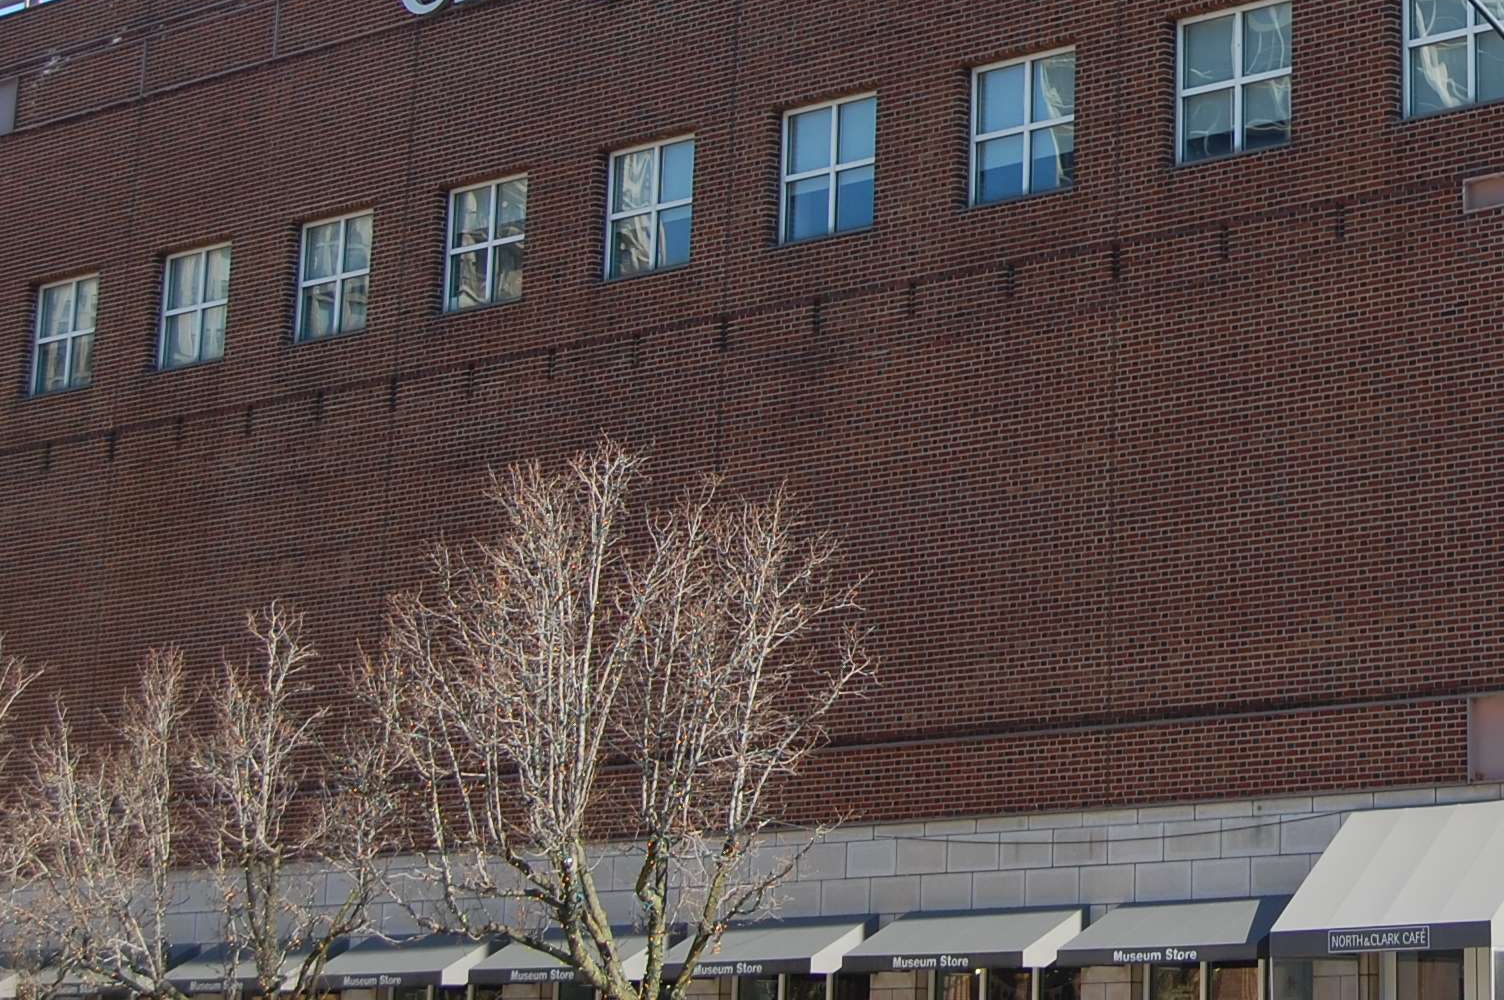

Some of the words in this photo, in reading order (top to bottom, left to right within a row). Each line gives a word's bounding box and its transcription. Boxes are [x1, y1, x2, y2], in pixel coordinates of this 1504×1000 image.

[1402, 927, 1427, 945] CAFÉ
[892, 956, 937, 969] Museum
[940, 954, 969, 967] Store
[1113, 949, 1162, 962] Museum
[1165, 947, 1197, 961] Store
[510, 969, 548, 981] Museum
[550, 968, 575, 980] Store
[736, 962, 763, 974] Store
[343, 975, 378, 986] Museum
[380, 974, 402, 985] Store
